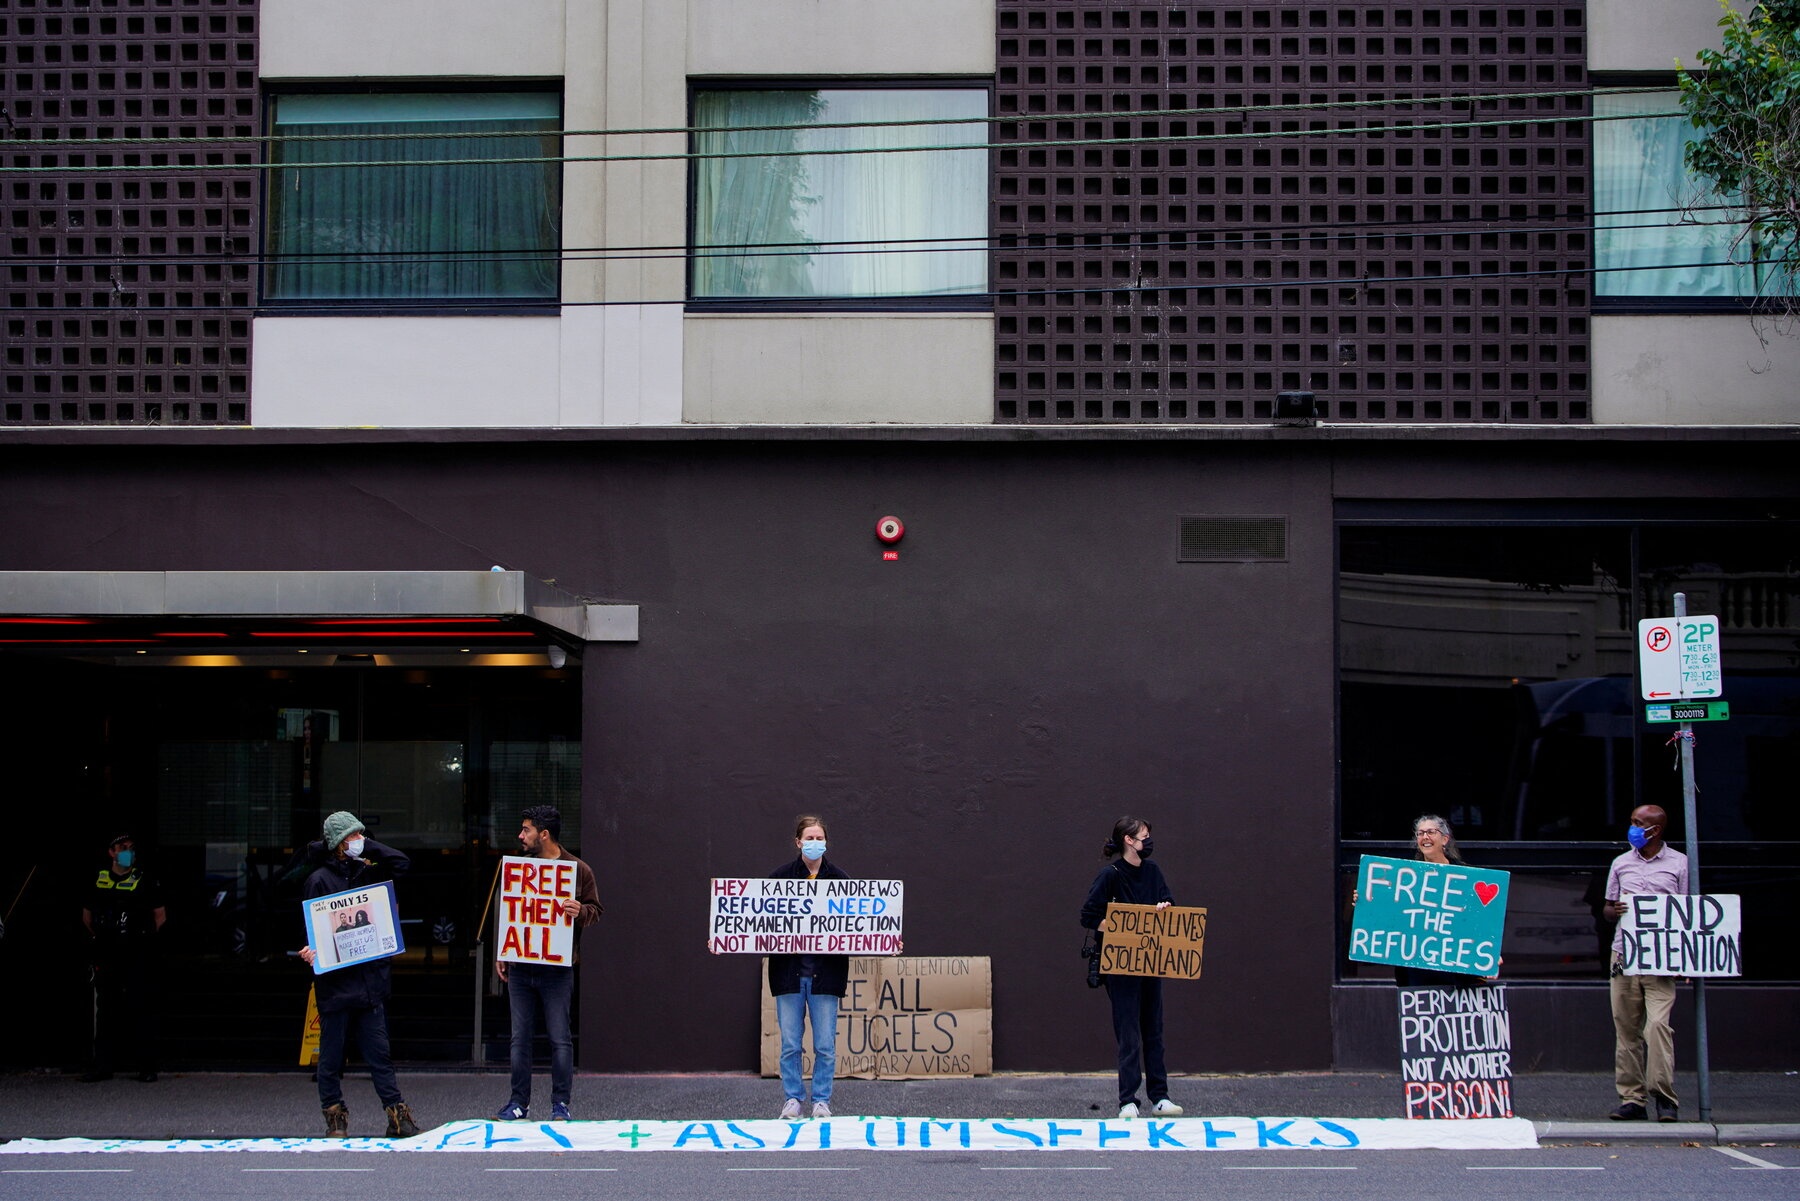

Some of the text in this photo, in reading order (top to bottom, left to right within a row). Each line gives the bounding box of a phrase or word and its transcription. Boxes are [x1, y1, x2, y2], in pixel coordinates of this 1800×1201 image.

[1683, 623, 1715, 643] 2P
[1686, 644, 1712, 652] METER
[1674, 710, 1704, 719] 30001119
[504, 862, 573, 897] FREE
[714, 879, 901, 897] HEY KAREN ANDREWS
[1365, 862, 1468, 912] FREE
[330, 893, 369, 910] ONLY 15
[502, 895, 572, 927] THEM
[718, 897, 886, 915] REFUGEES NEED
[1633, 894, 1724, 931] END
[714, 915, 901, 933] PERMANENT PROTECTION
[1402, 908, 1455, 935] THE
[349, 944, 368, 957] FREE
[501, 925, 564, 963] ALL
[713, 934, 902, 952] NOT INDEFINITE DETENTION
[1140, 935, 1160, 951] ON
[1351, 928, 1494, 971] REFUGEES
[1620, 928, 1742, 974] DETENTION
[897, 958, 969, 976] DETENTION
[878, 978, 933, 1012] ALL
[1400, 985, 1507, 1015] PERMANENT
[1400, 1010, 1511, 1053] PROTECTION
[921, 1054, 971, 1074] VISAS
[1401, 1051, 1513, 1082] NOT ANOTHER
[1405, 1080, 1513, 1119] PRISON!
